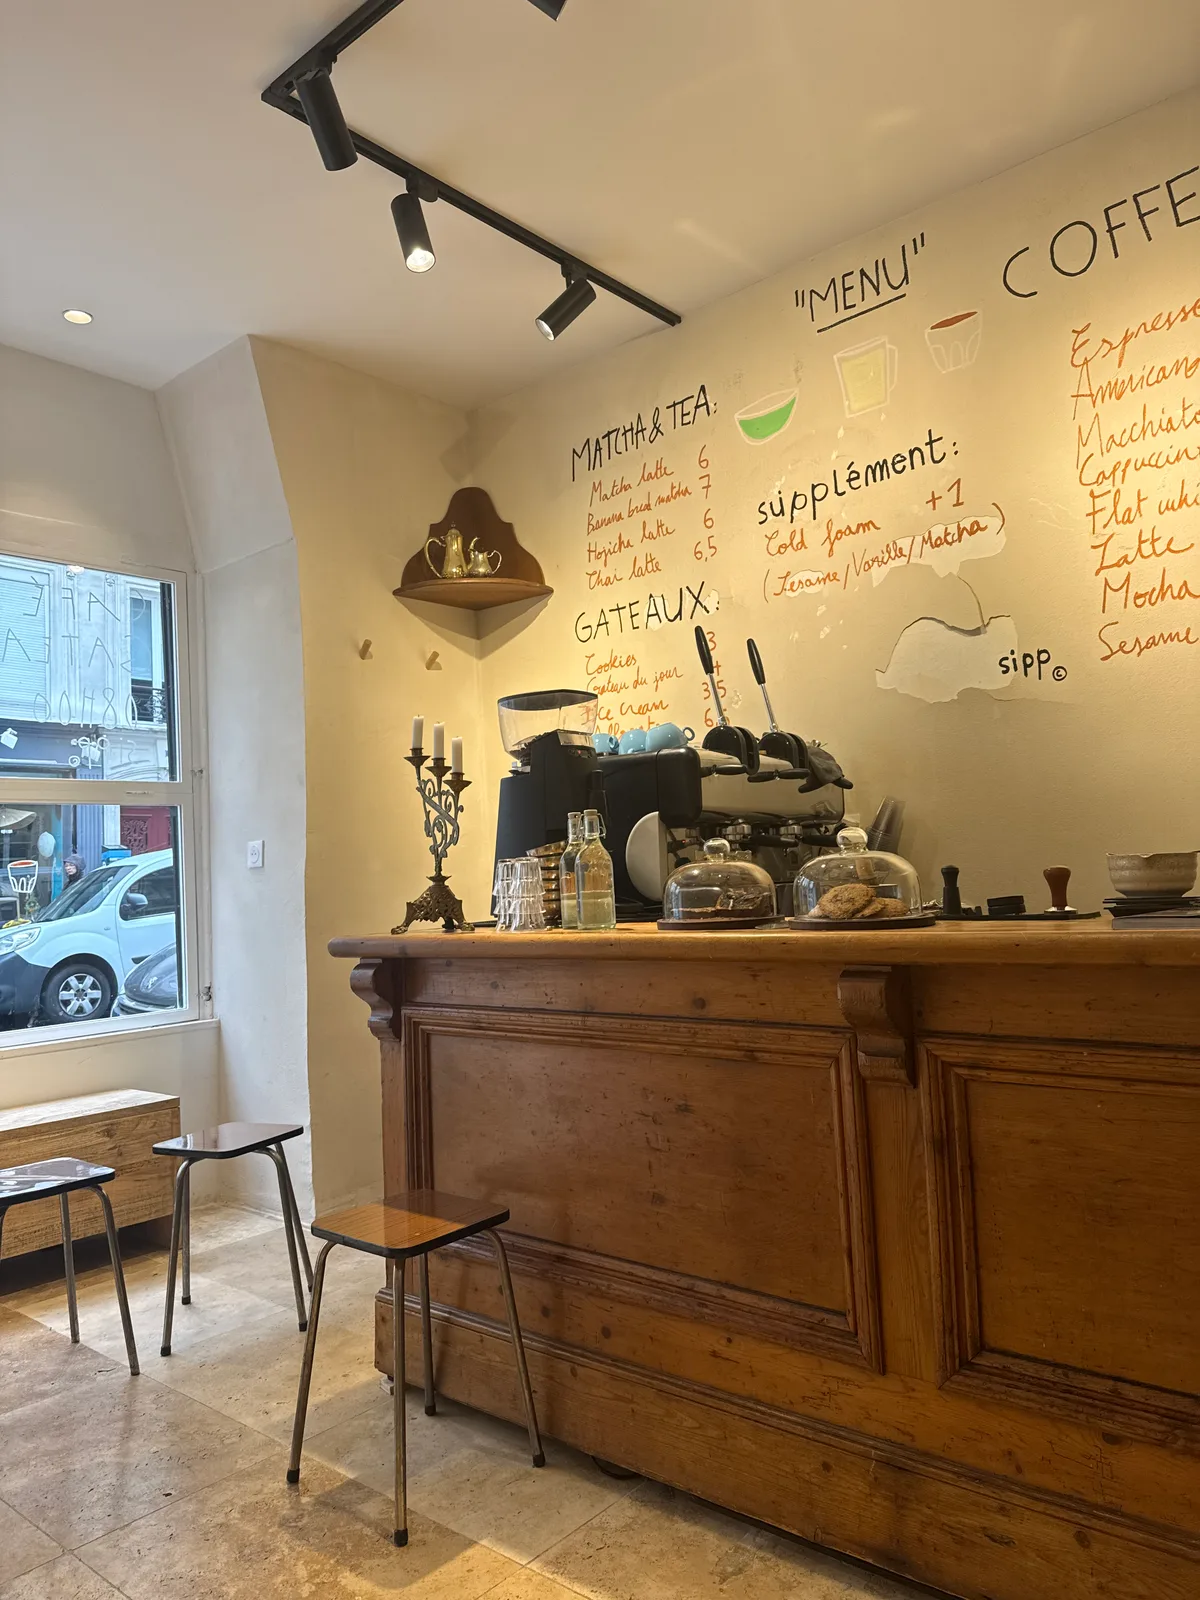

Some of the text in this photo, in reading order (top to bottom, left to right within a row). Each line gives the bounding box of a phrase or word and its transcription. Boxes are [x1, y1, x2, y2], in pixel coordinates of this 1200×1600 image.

[572, 413, 647, 482] MATCHA
[648, 407, 664, 443] &
[1079, 444, 1200, 487] Cappuccin
[590, 444, 709, 507] Matcha latte 6
[587, 512, 624, 536] Banana
[655, 481, 692, 506] matcha
[699, 474, 711, 499] 7
[1086, 488, 1148, 535] Flat
[587, 508, 714, 567] Hojicha latte 6
[629, 552, 662, 580] latte
[694, 535, 718, 562] 6,5
[765, 528, 808, 556] Cold
[821, 518, 881, 557] foam
[1090, 525, 1195, 577] Latte
[1102, 567, 1200, 614] Mocha
[585, 649, 637, 675] Cookies
[1098, 620, 1200, 661] Sesame
[633, 666, 648, 689] du
[653, 667, 684, 692] jour
[702, 679, 727, 700] 35
